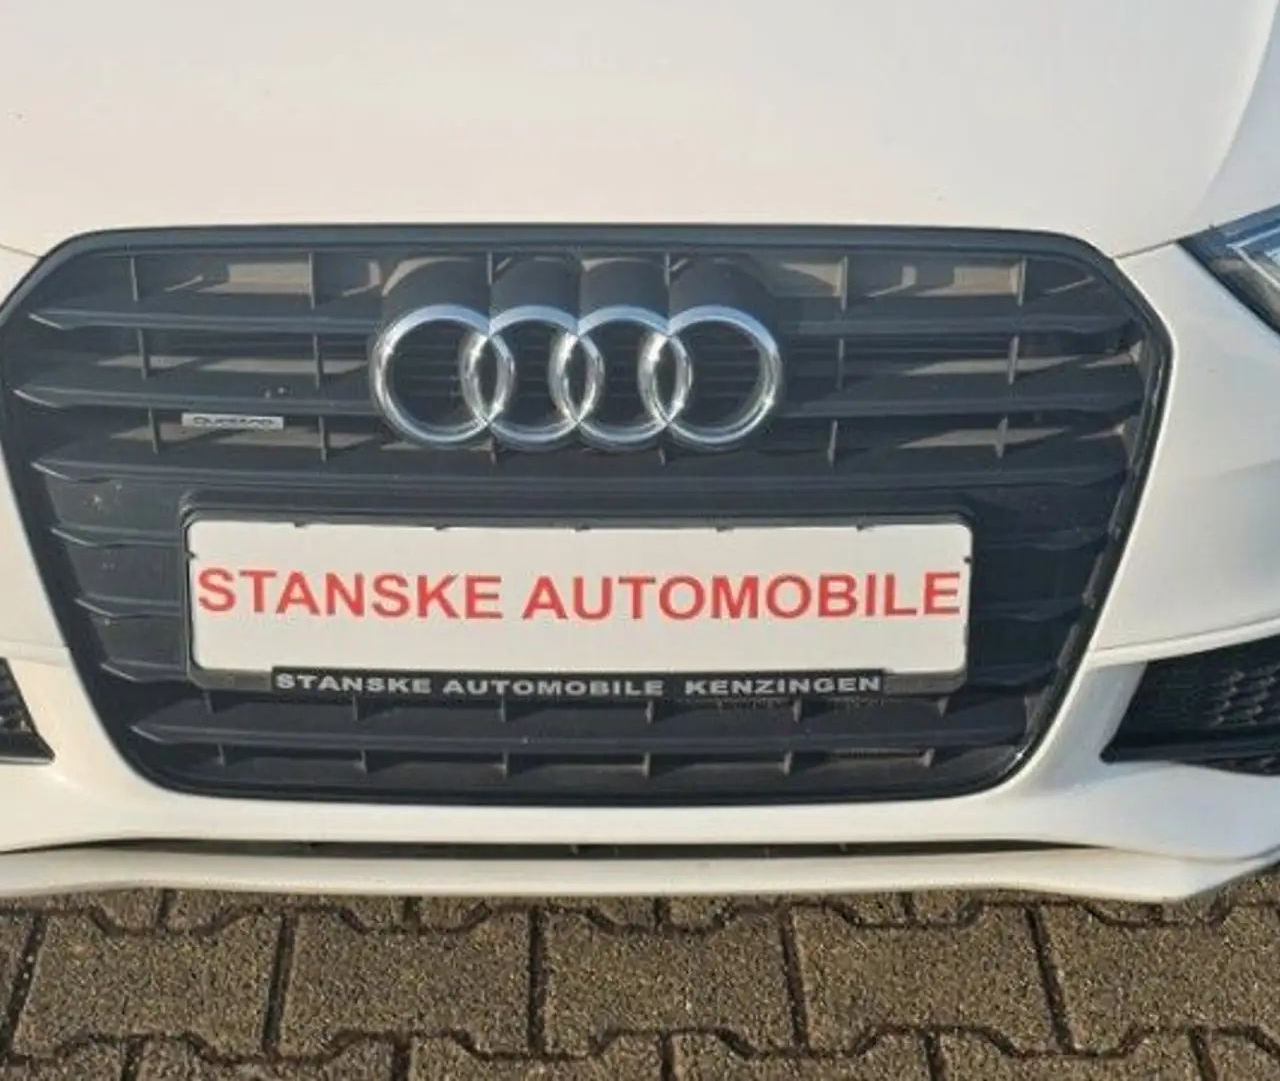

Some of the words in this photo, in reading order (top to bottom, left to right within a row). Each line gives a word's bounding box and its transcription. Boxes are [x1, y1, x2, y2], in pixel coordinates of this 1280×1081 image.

[198, 568, 502, 620] STANSKE
[522, 572, 961, 620] AUTOMOBILE
[275, 674, 431, 694] STANSKE
[442, 679, 663, 697] AUTOMOBILE
[684, 676, 880, 696] KENZINGEN
